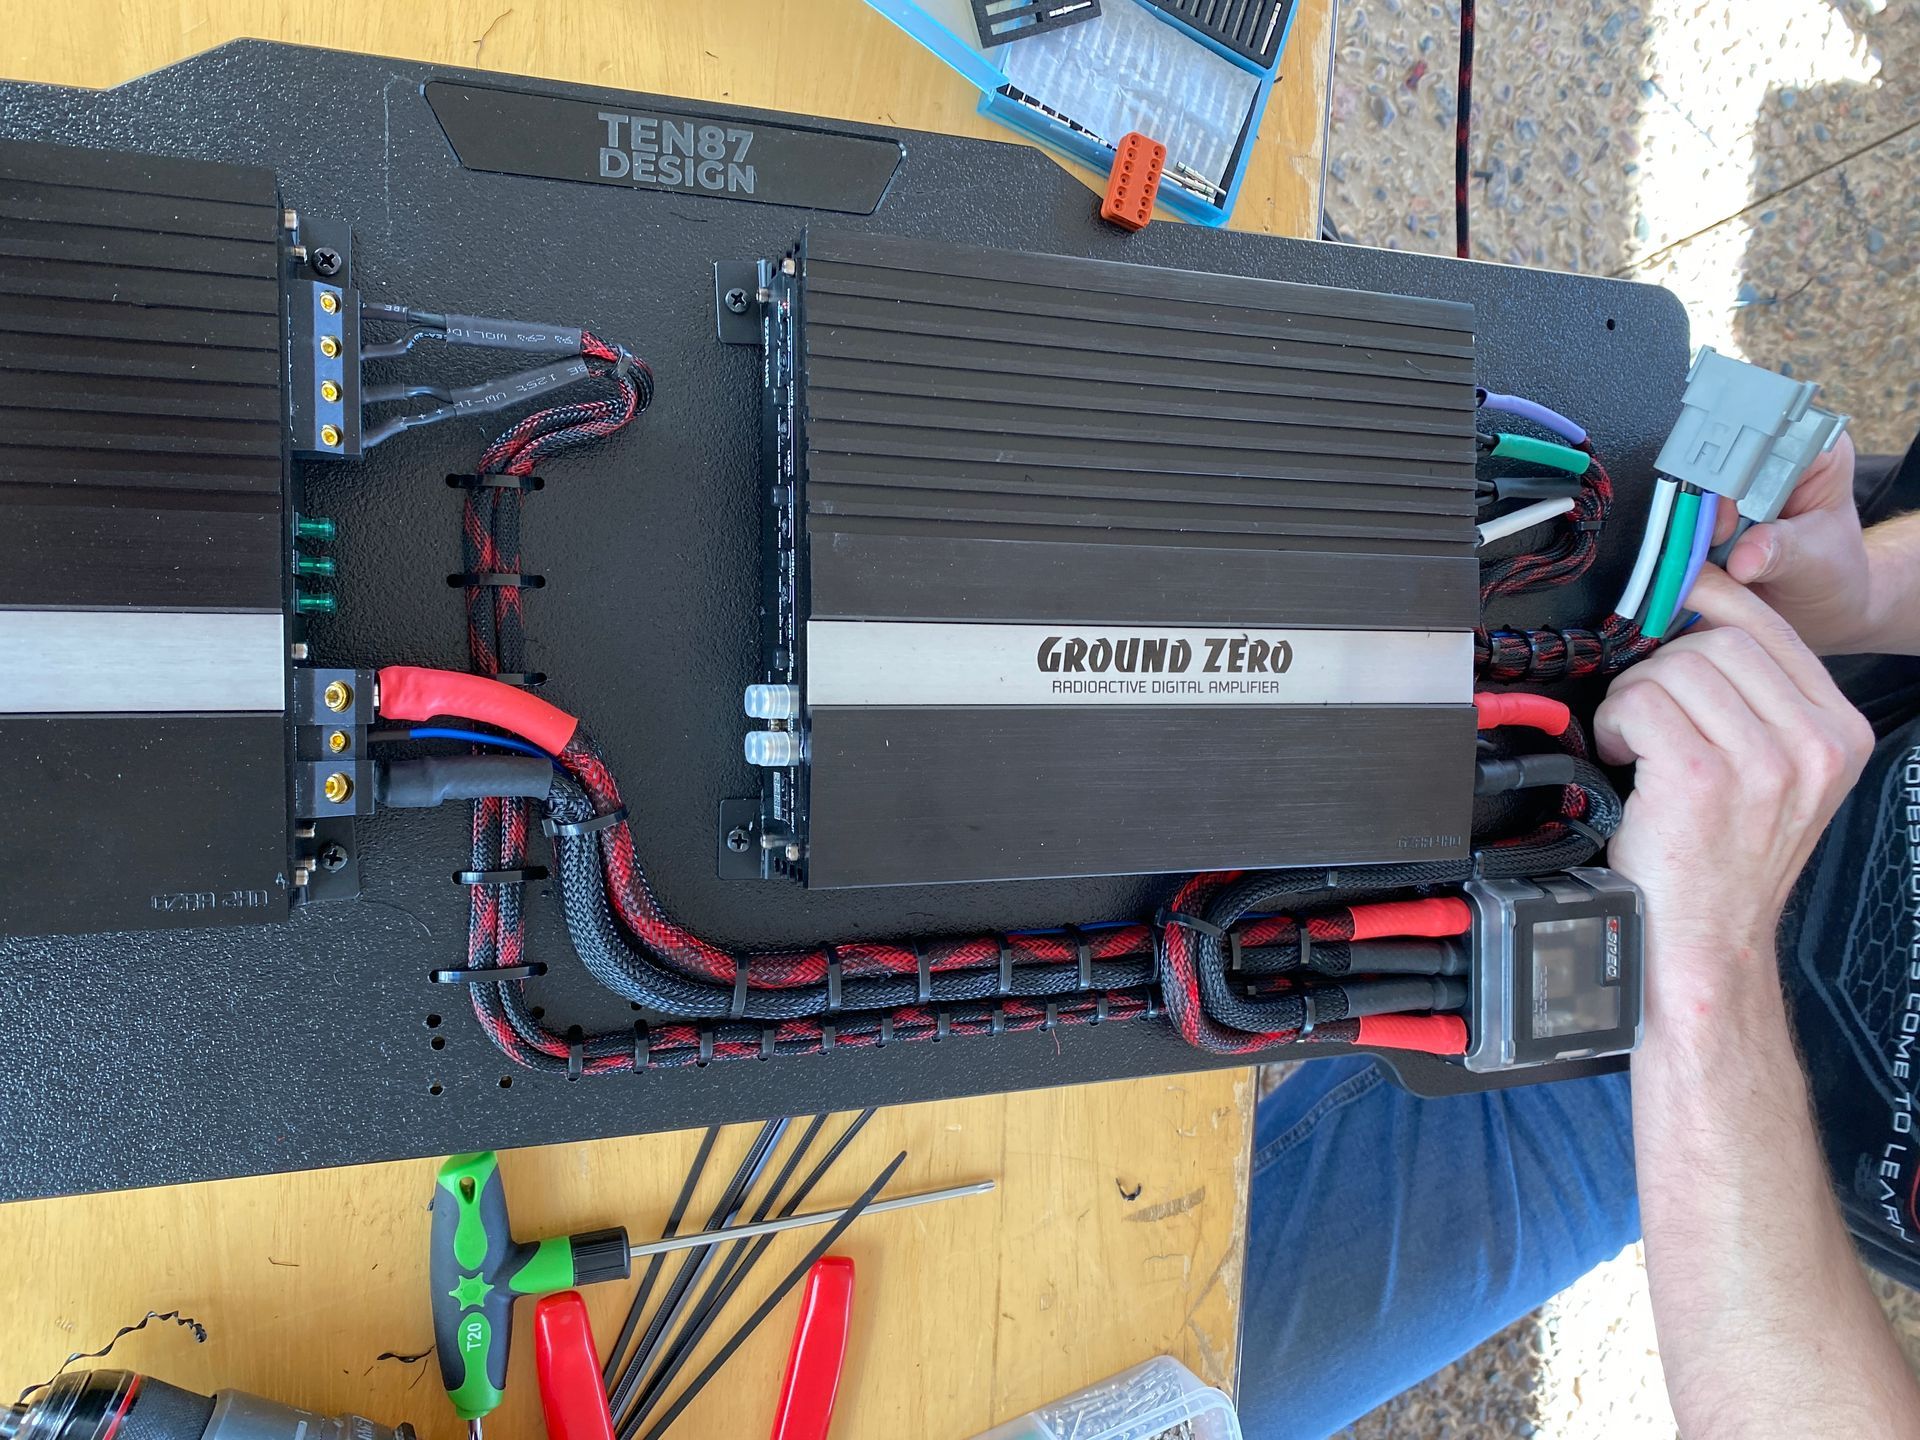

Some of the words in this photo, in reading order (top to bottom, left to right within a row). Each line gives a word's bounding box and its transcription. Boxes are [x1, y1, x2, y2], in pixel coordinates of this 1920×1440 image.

[598, 112, 754, 162] TEN87
[600, 147, 755, 194] DESIGN
[1037, 637, 1192, 673] GROUND
[1202, 637, 1293, 674] ZERO
[1052, 680, 1146, 693] RADIOACTIVE
[1152, 680, 1203, 693] DIGITAL
[1208, 681, 1279, 693] AMPLIFIER
[1893, 992, 1920, 1079] COME
[1893, 1092, 1912, 1134] TO
[466, 1323, 482, 1352] T20
